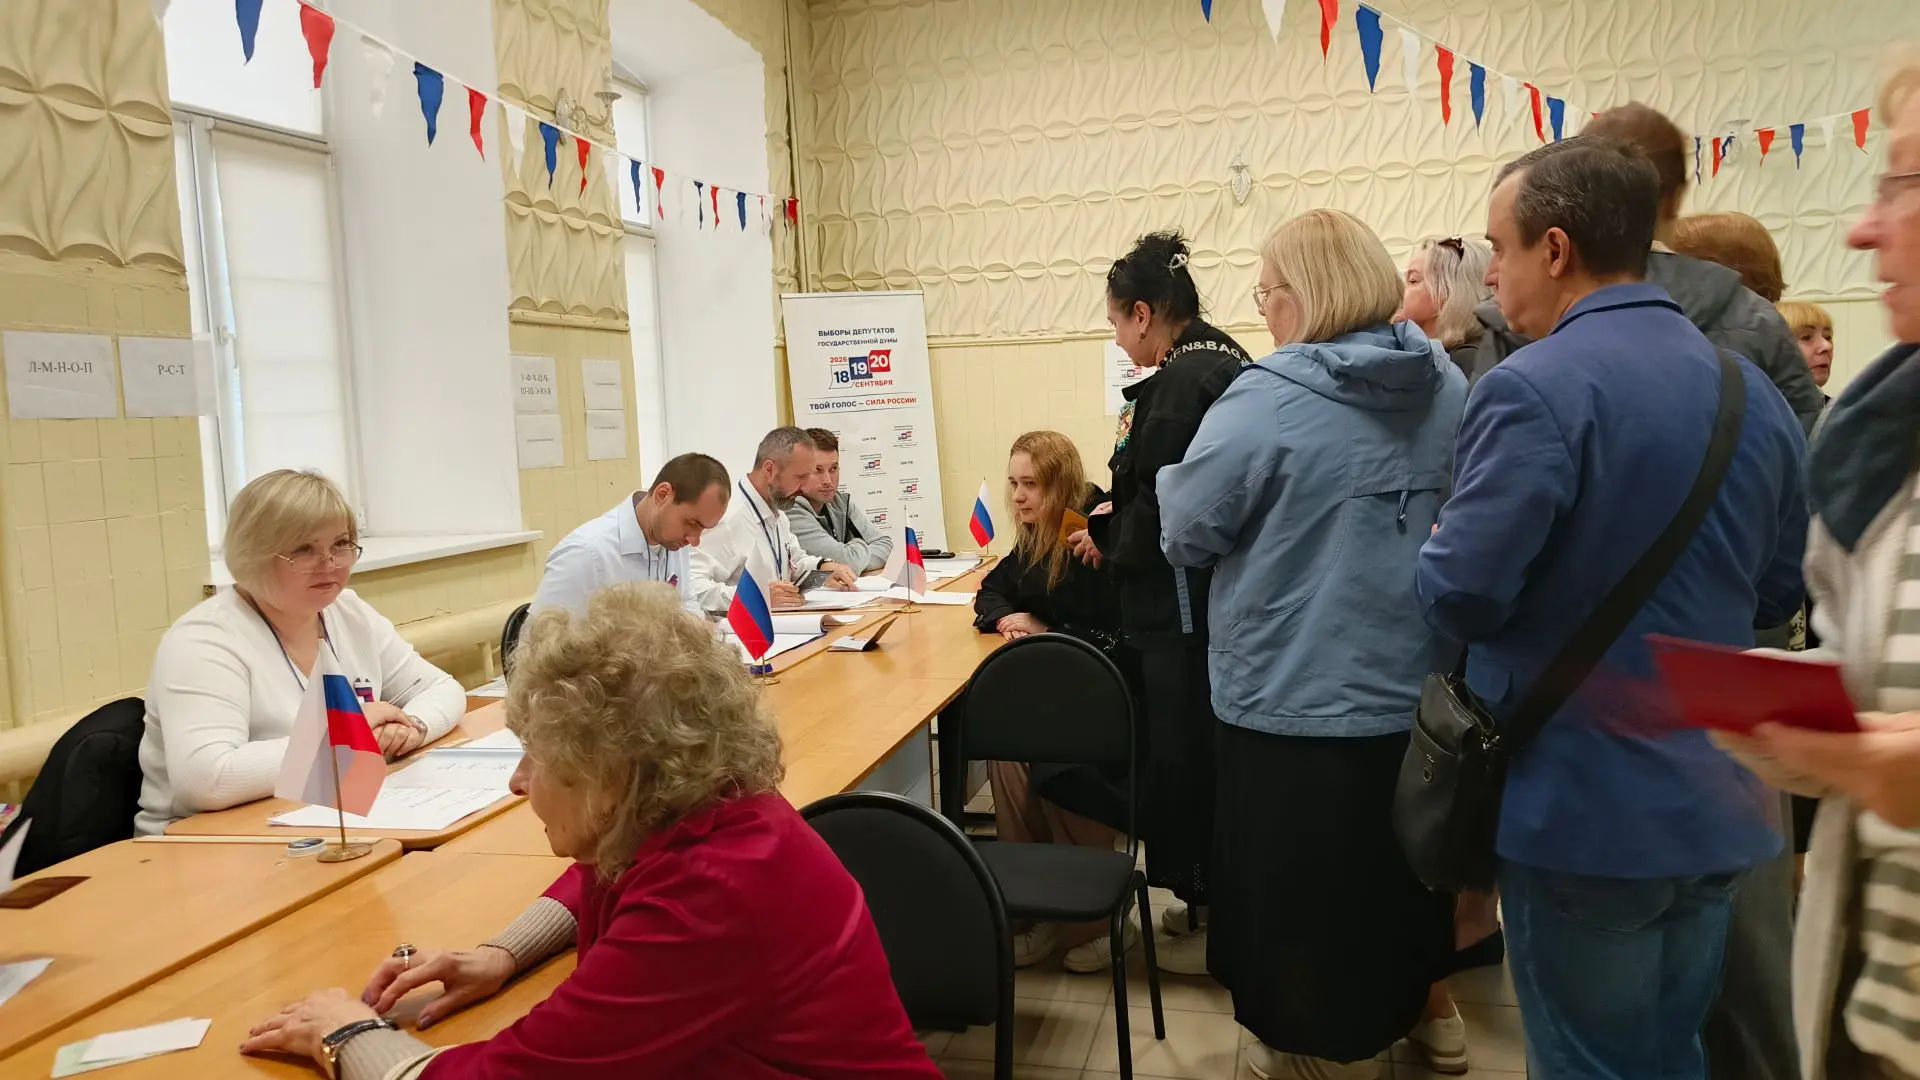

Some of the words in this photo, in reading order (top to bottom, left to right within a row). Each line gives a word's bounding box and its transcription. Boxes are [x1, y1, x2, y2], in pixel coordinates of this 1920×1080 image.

[818, 329, 851, 337] ВЫБОРЫ
[852, 327, 895, 336] ДЕПУТАТОВ
[817, 338, 879, 347] ГОСУДАРСТВЕННОЙ
[28, 361, 93, 374] Л-М-Н-О-П
[157, 364, 187, 376] Р-С-Т
[833, 370, 850, 383] 18
[850, 362, 868, 375] 19
[869, 354, 889, 368] 20
[855, 379, 894, 388] СЕНТЯБРЯ
[809, 401, 831, 410] ТВОЙ
[831, 401, 857, 409] ГОЛОС
[887, 397, 917, 405] РОССИИ!
